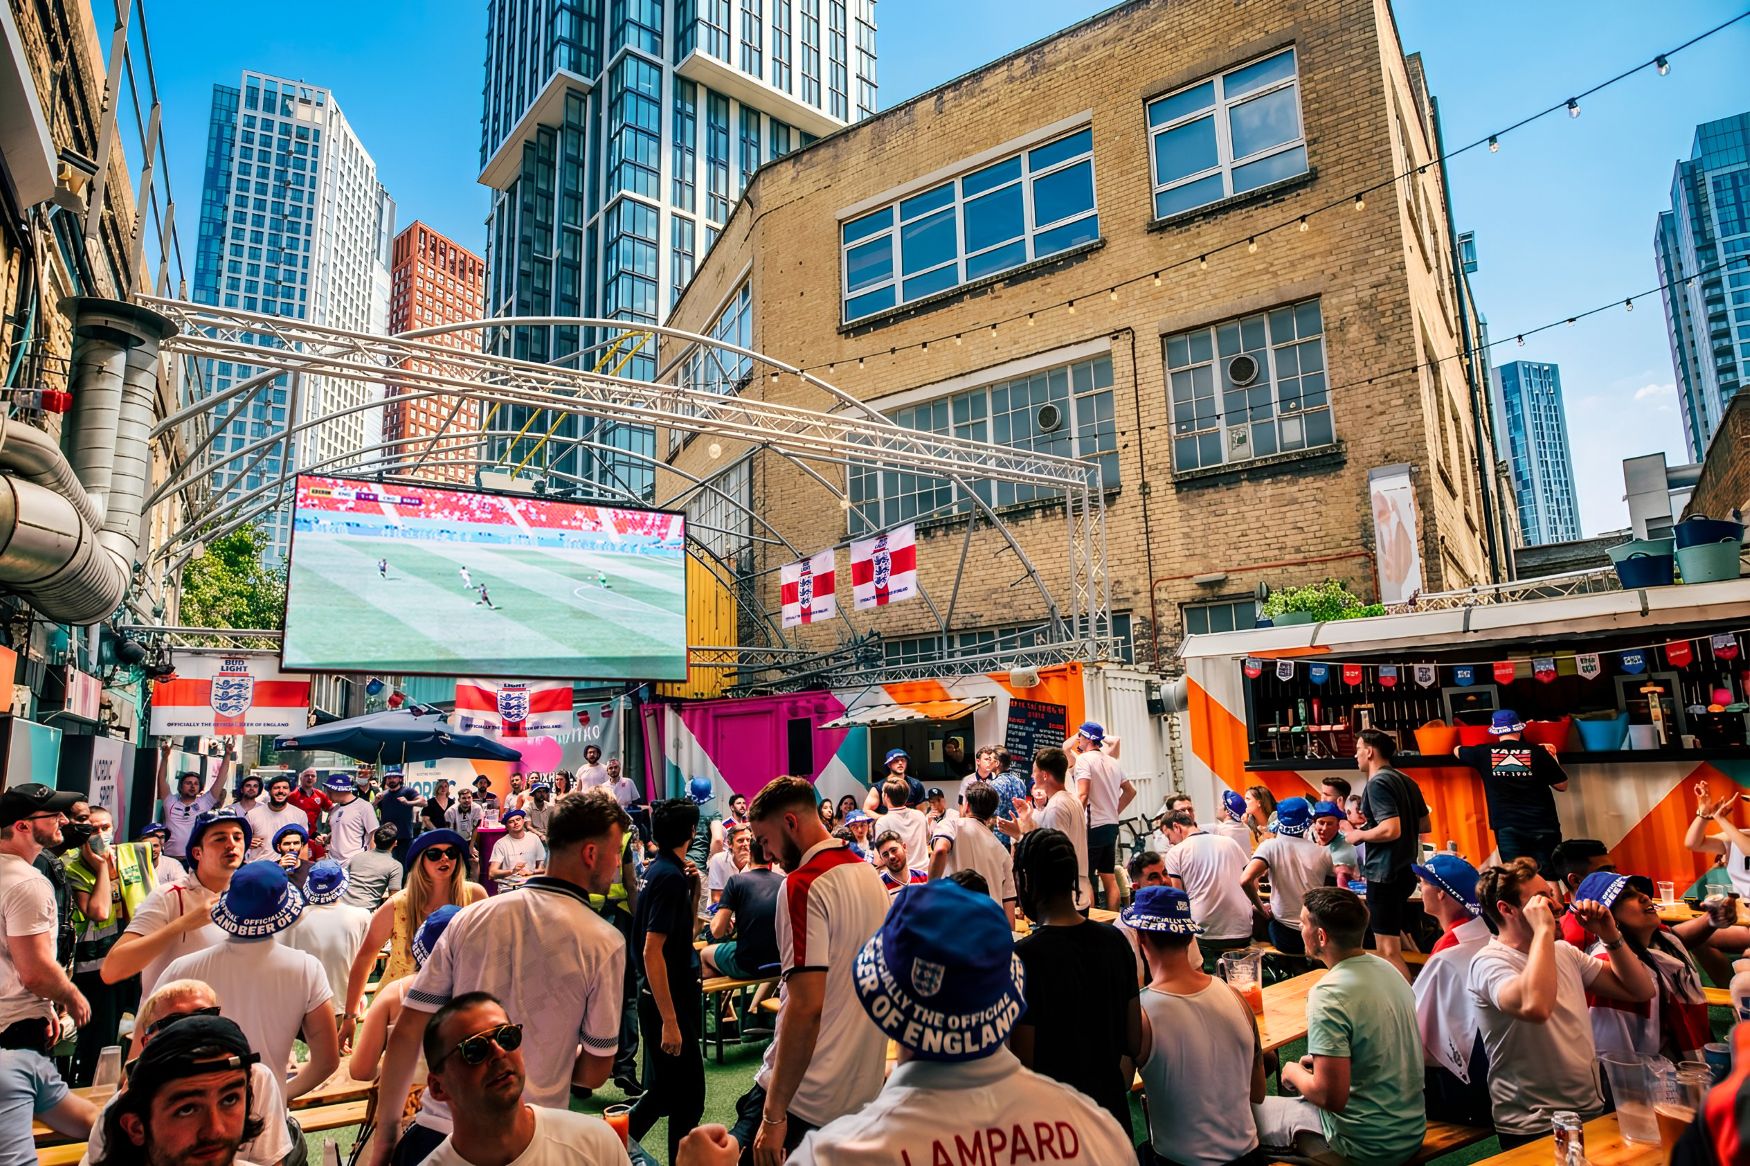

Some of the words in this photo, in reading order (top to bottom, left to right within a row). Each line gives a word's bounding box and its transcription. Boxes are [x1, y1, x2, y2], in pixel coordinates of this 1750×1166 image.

[1604, 878, 1626, 908] BEER
[238, 923, 276, 936] BEER
[278, 913, 294, 928] OF
[243, 908, 287, 926] OFFICIALLY
[1132, 919, 1166, 931] BEER
[1169, 923, 1186, 934] OF
[1140, 914, 1182, 925] OFFICIALLY
[913, 1003, 945, 1029] THE
[947, 991, 1010, 1030] OFFICIAL
[871, 994, 905, 1030] OF
[903, 1000, 1020, 1055] ENGLAND
